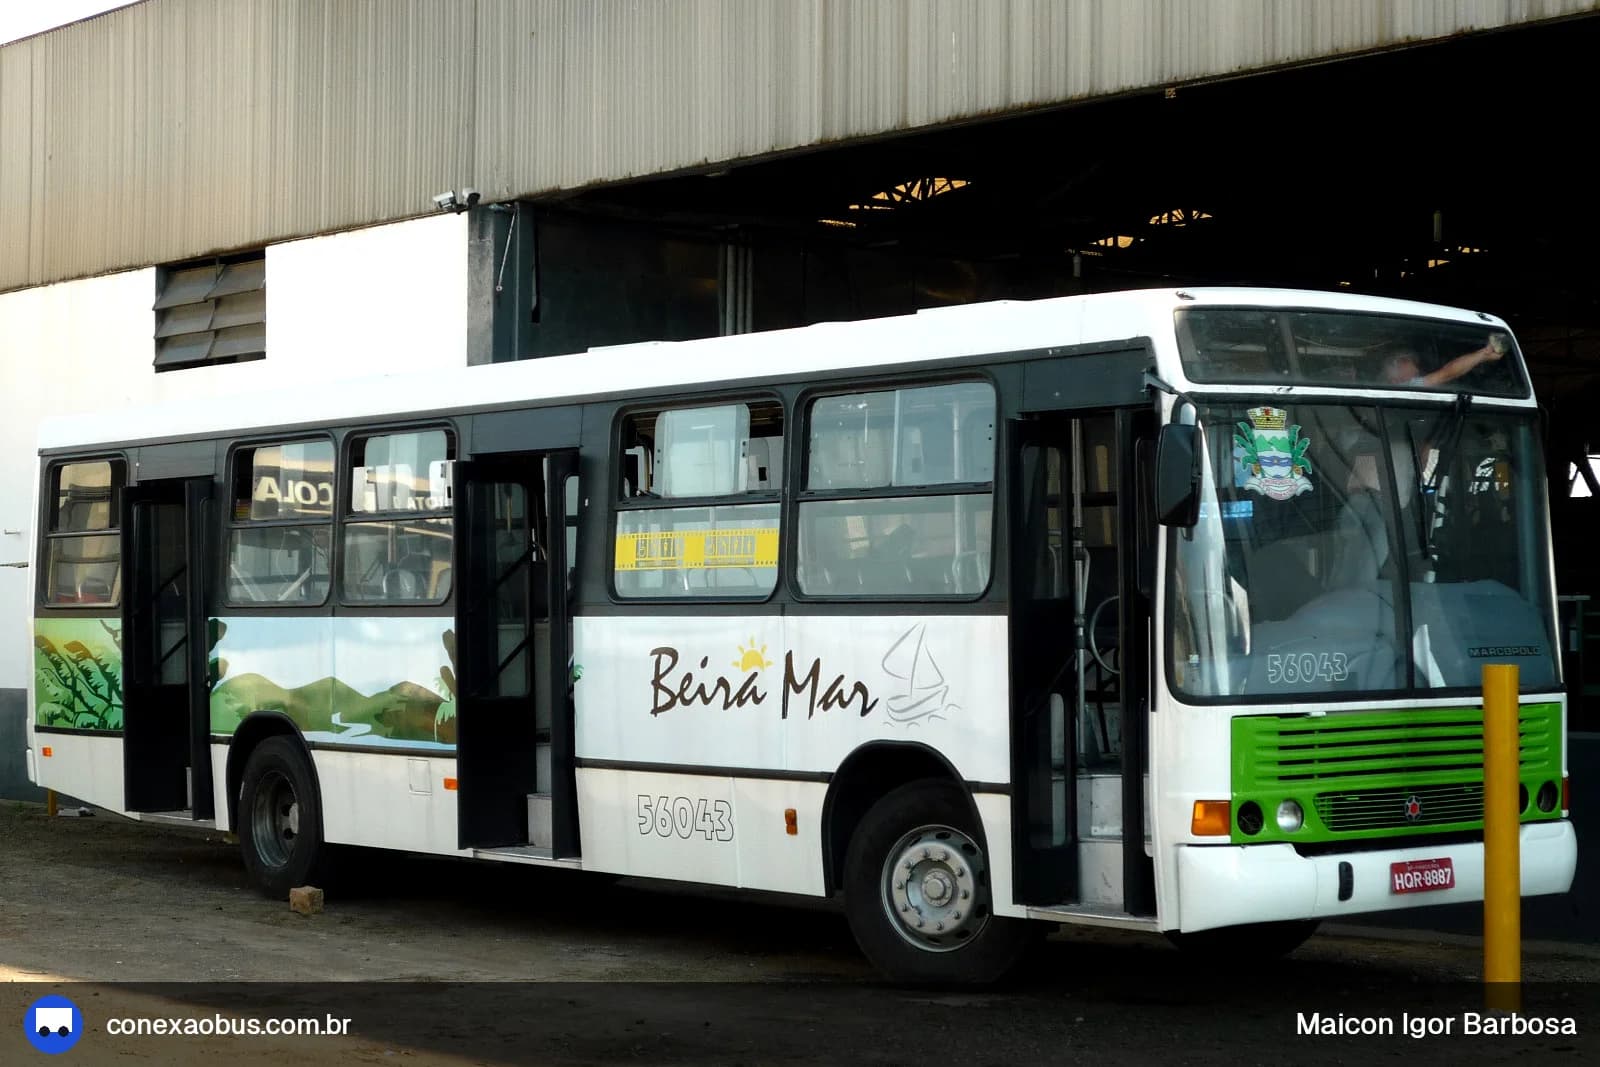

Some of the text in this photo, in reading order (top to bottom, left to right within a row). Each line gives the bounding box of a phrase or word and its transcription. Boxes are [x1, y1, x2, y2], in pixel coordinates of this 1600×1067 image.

[1267, 652, 1349, 684] 56043
[1469, 646, 1541, 657] MARCOPOLO
[649, 646, 880, 720] Beira Mar
[637, 794, 735, 842] 56043
